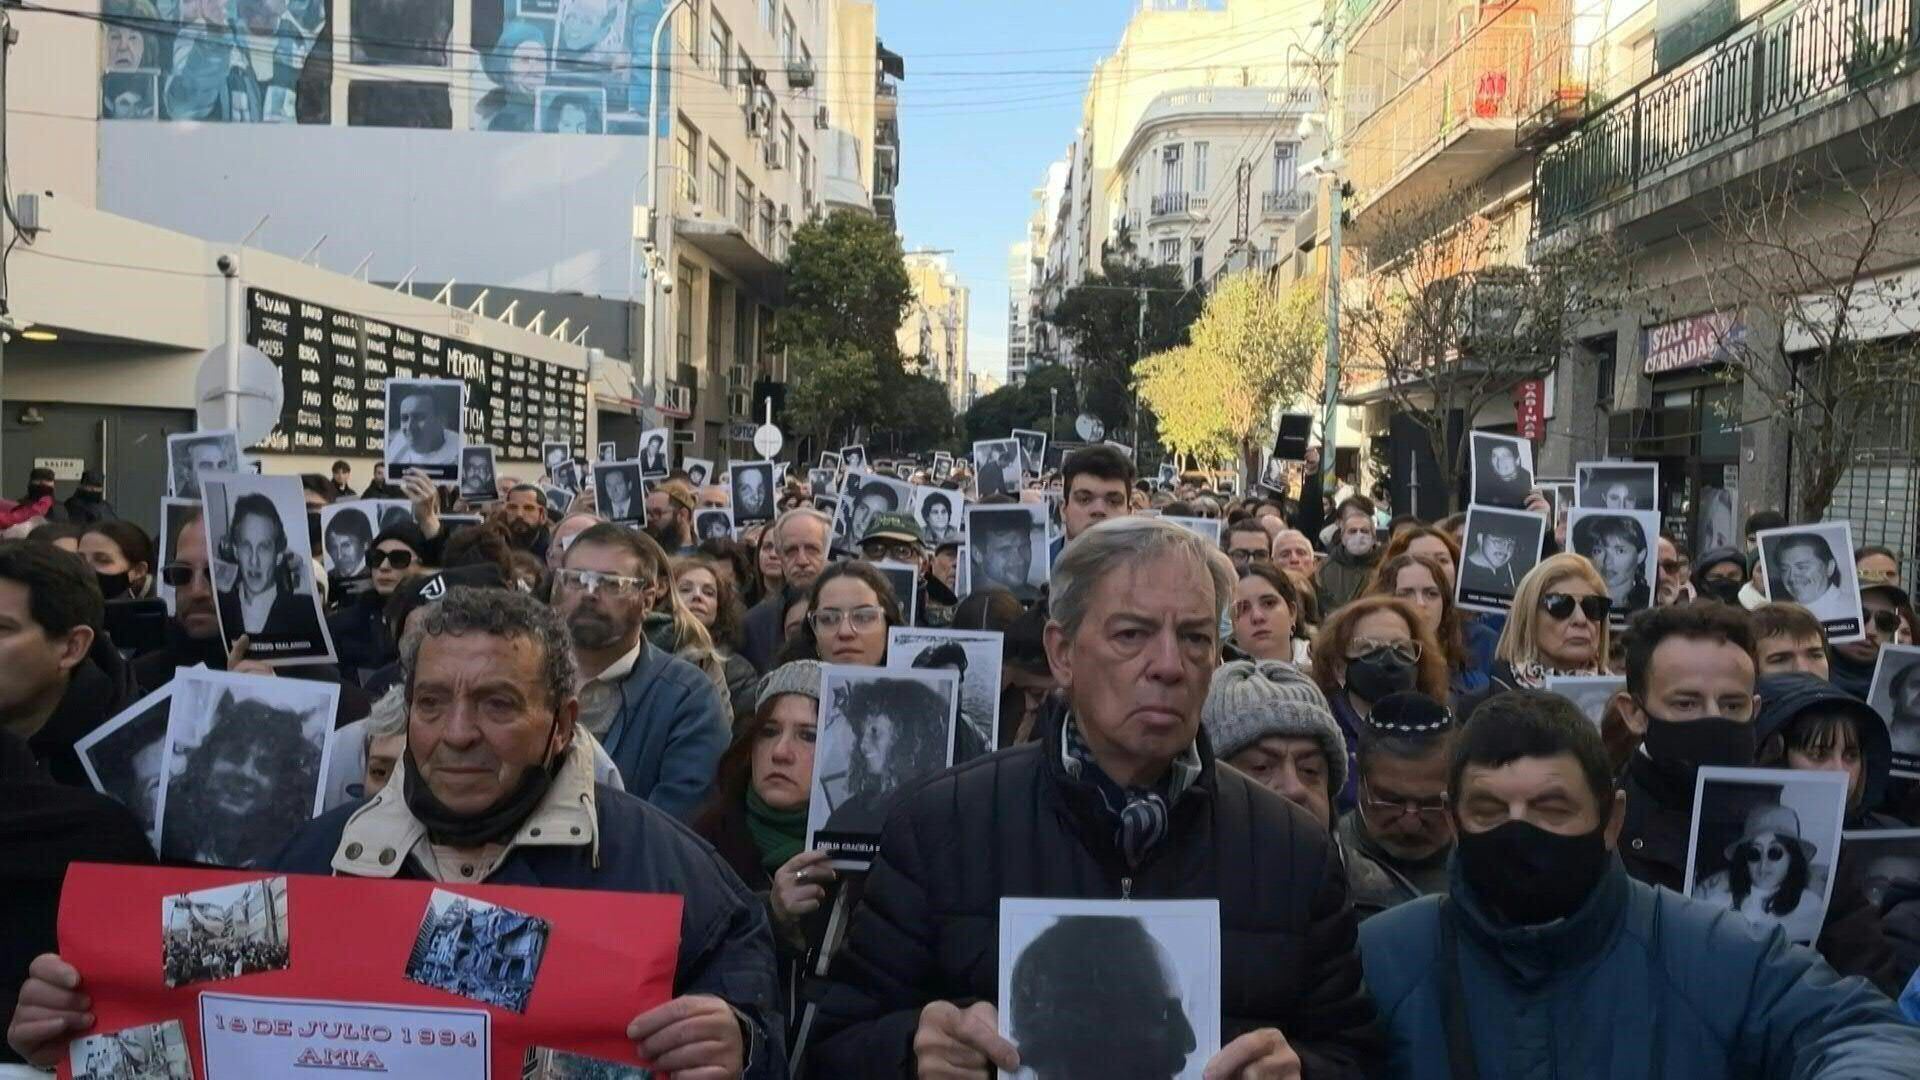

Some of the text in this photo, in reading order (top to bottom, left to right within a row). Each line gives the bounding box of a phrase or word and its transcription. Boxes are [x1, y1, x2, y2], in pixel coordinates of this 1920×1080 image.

[255, 291, 291, 315] SILVANA
[262, 317, 288, 336] JORGE
[447, 347, 486, 385] MEMORIA
[841, 842, 874, 852] GRACIELA
[252, 1018, 292, 1037] DE
[298, 1020, 392, 1042] JULIO
[401, 1027, 477, 1048] 1994
[297, 1047, 386, 1069] AMIA
